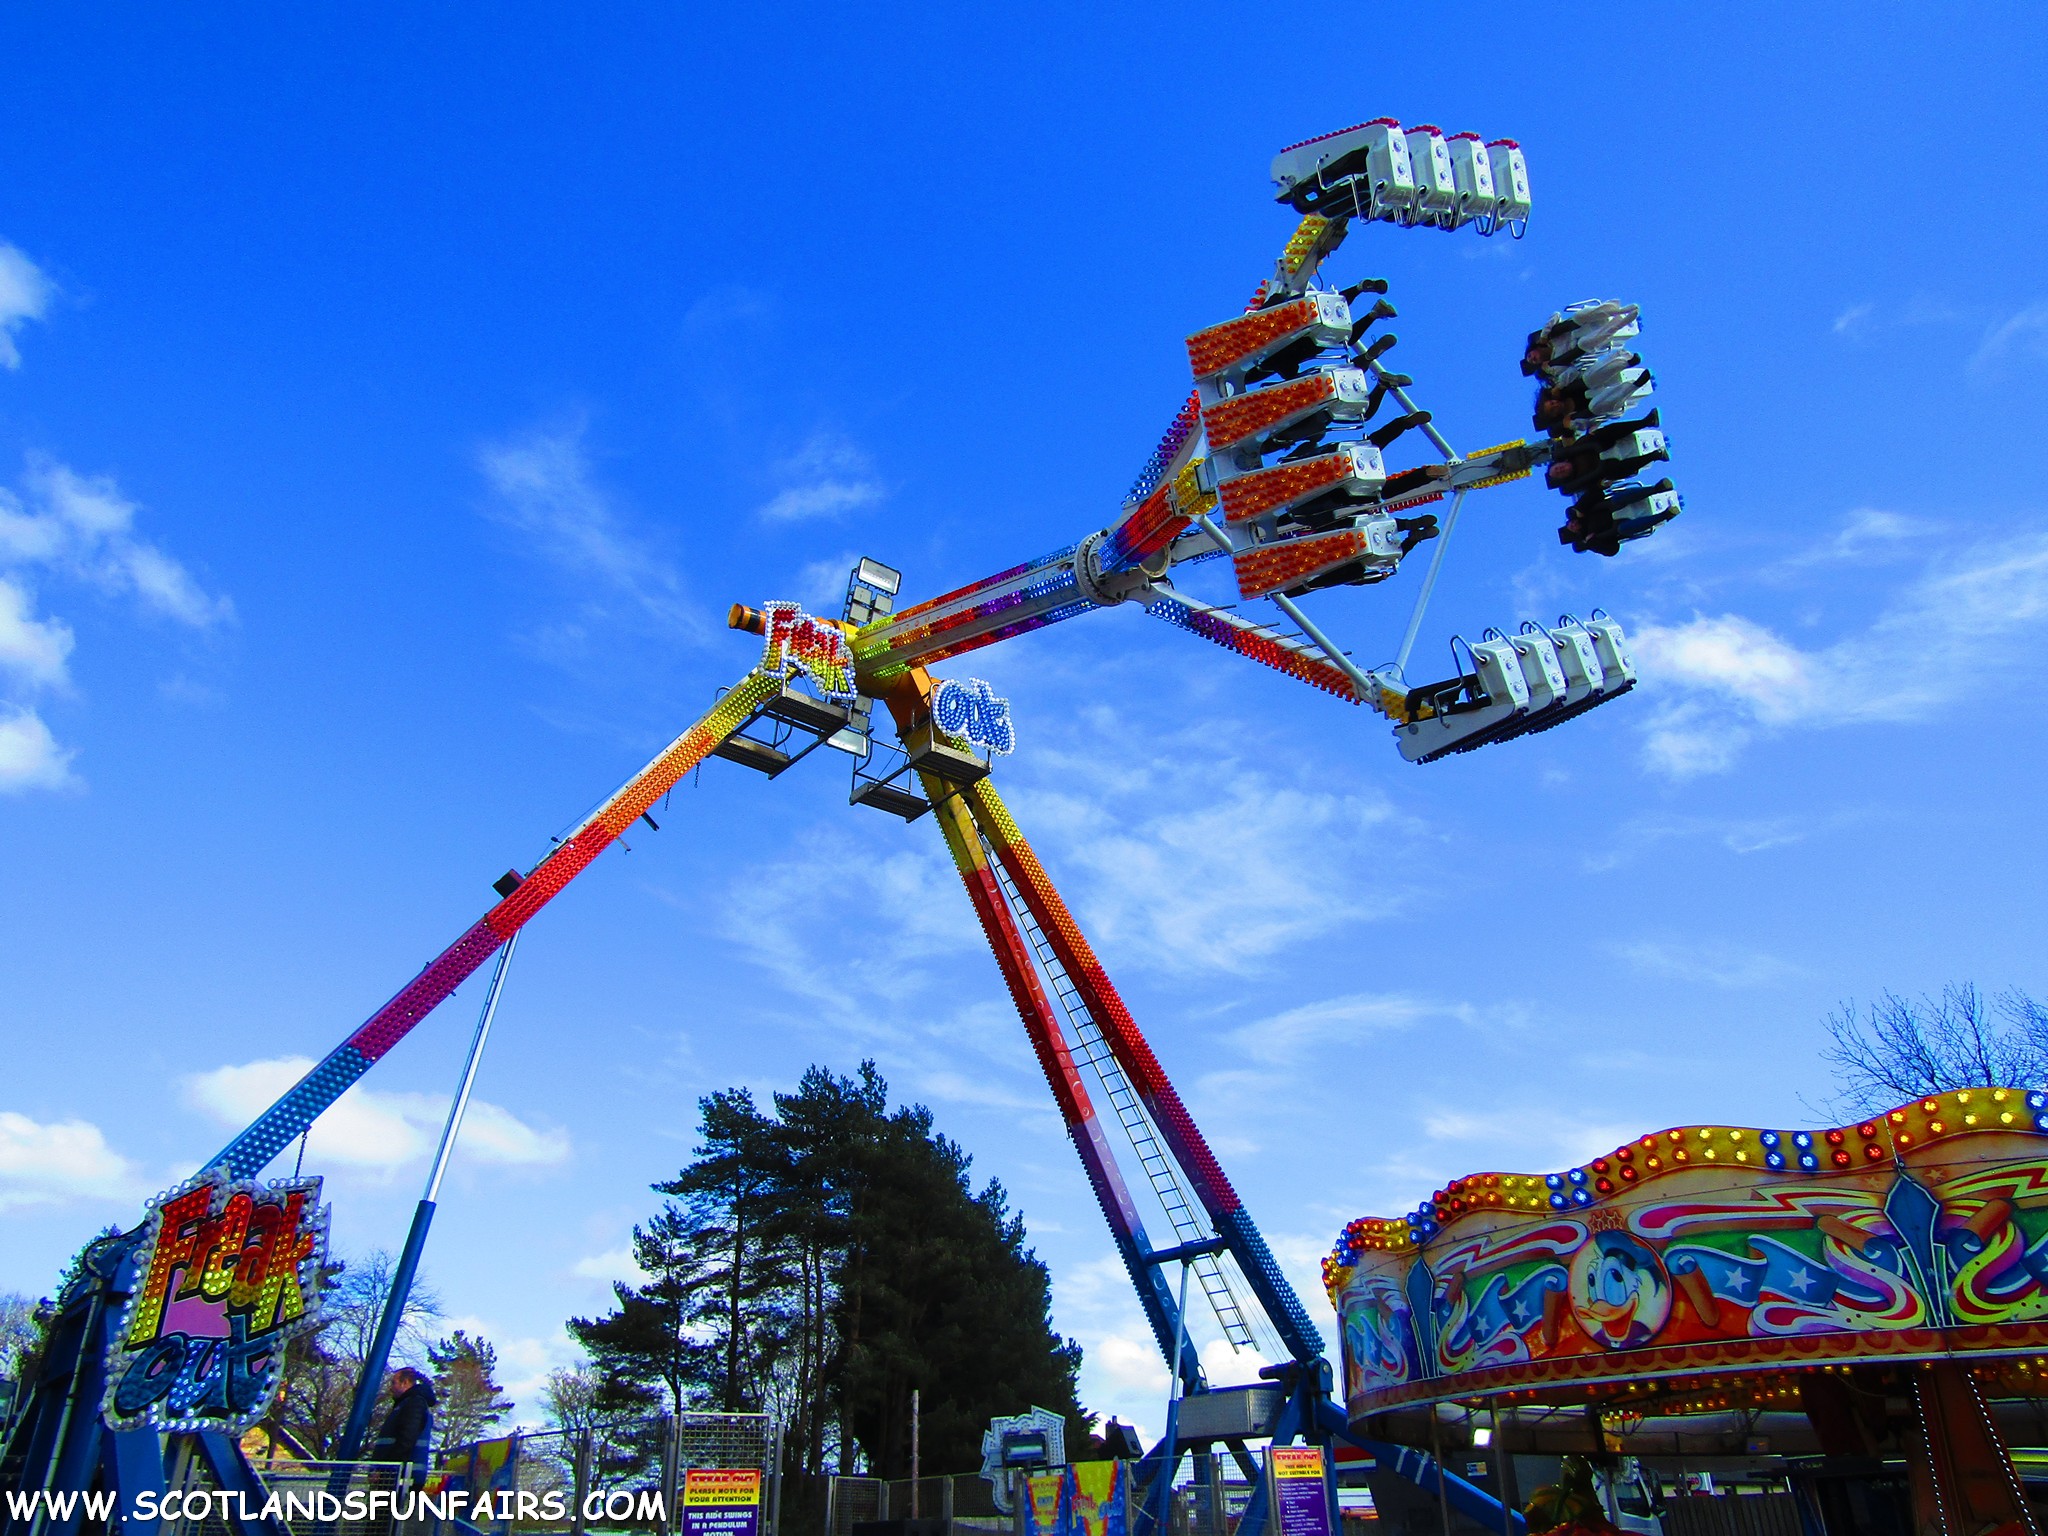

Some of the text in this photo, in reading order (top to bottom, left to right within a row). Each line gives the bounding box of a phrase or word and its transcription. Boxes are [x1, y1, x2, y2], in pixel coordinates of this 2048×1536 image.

[127, 1184, 315, 1346] Freak
[732, 1472, 756, 1485] OUT
[688, 1511, 753, 1520] THIS RIDE SWINGS
[691, 1522, 701, 1530] IN
[709, 1521, 748, 1530] PENDULUM
